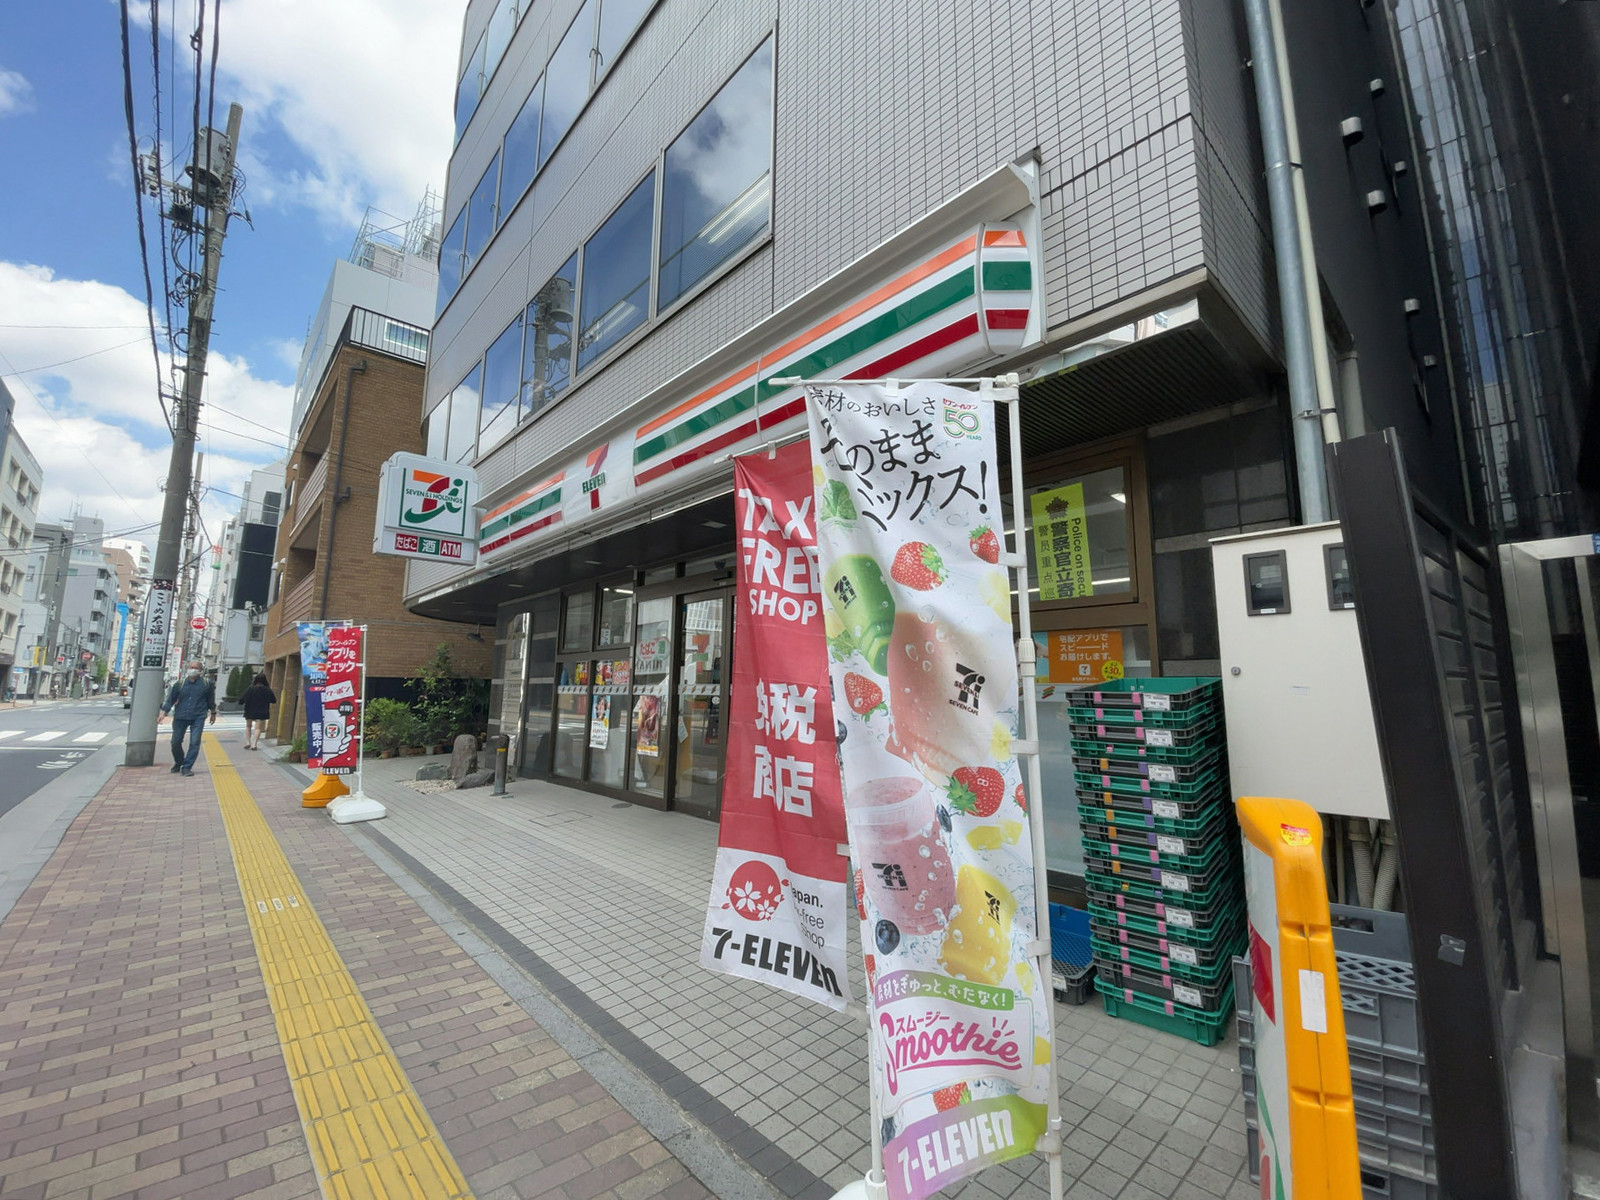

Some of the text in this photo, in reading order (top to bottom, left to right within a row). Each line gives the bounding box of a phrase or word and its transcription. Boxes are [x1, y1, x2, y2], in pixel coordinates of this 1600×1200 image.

[433, 493, 463, 504] HOLDINGS
[1071, 517, 1083, 552] Police
[396, 536, 417, 550] たばこ
[421, 539, 437, 553] 酒
[441, 542, 461, 556] ATM
[1075, 554, 1084, 569] on
[749, 588, 818, 625] SHOP
[895, 1011, 950, 1036] スムージー
[879, 1012, 1022, 1096] Smoothie
